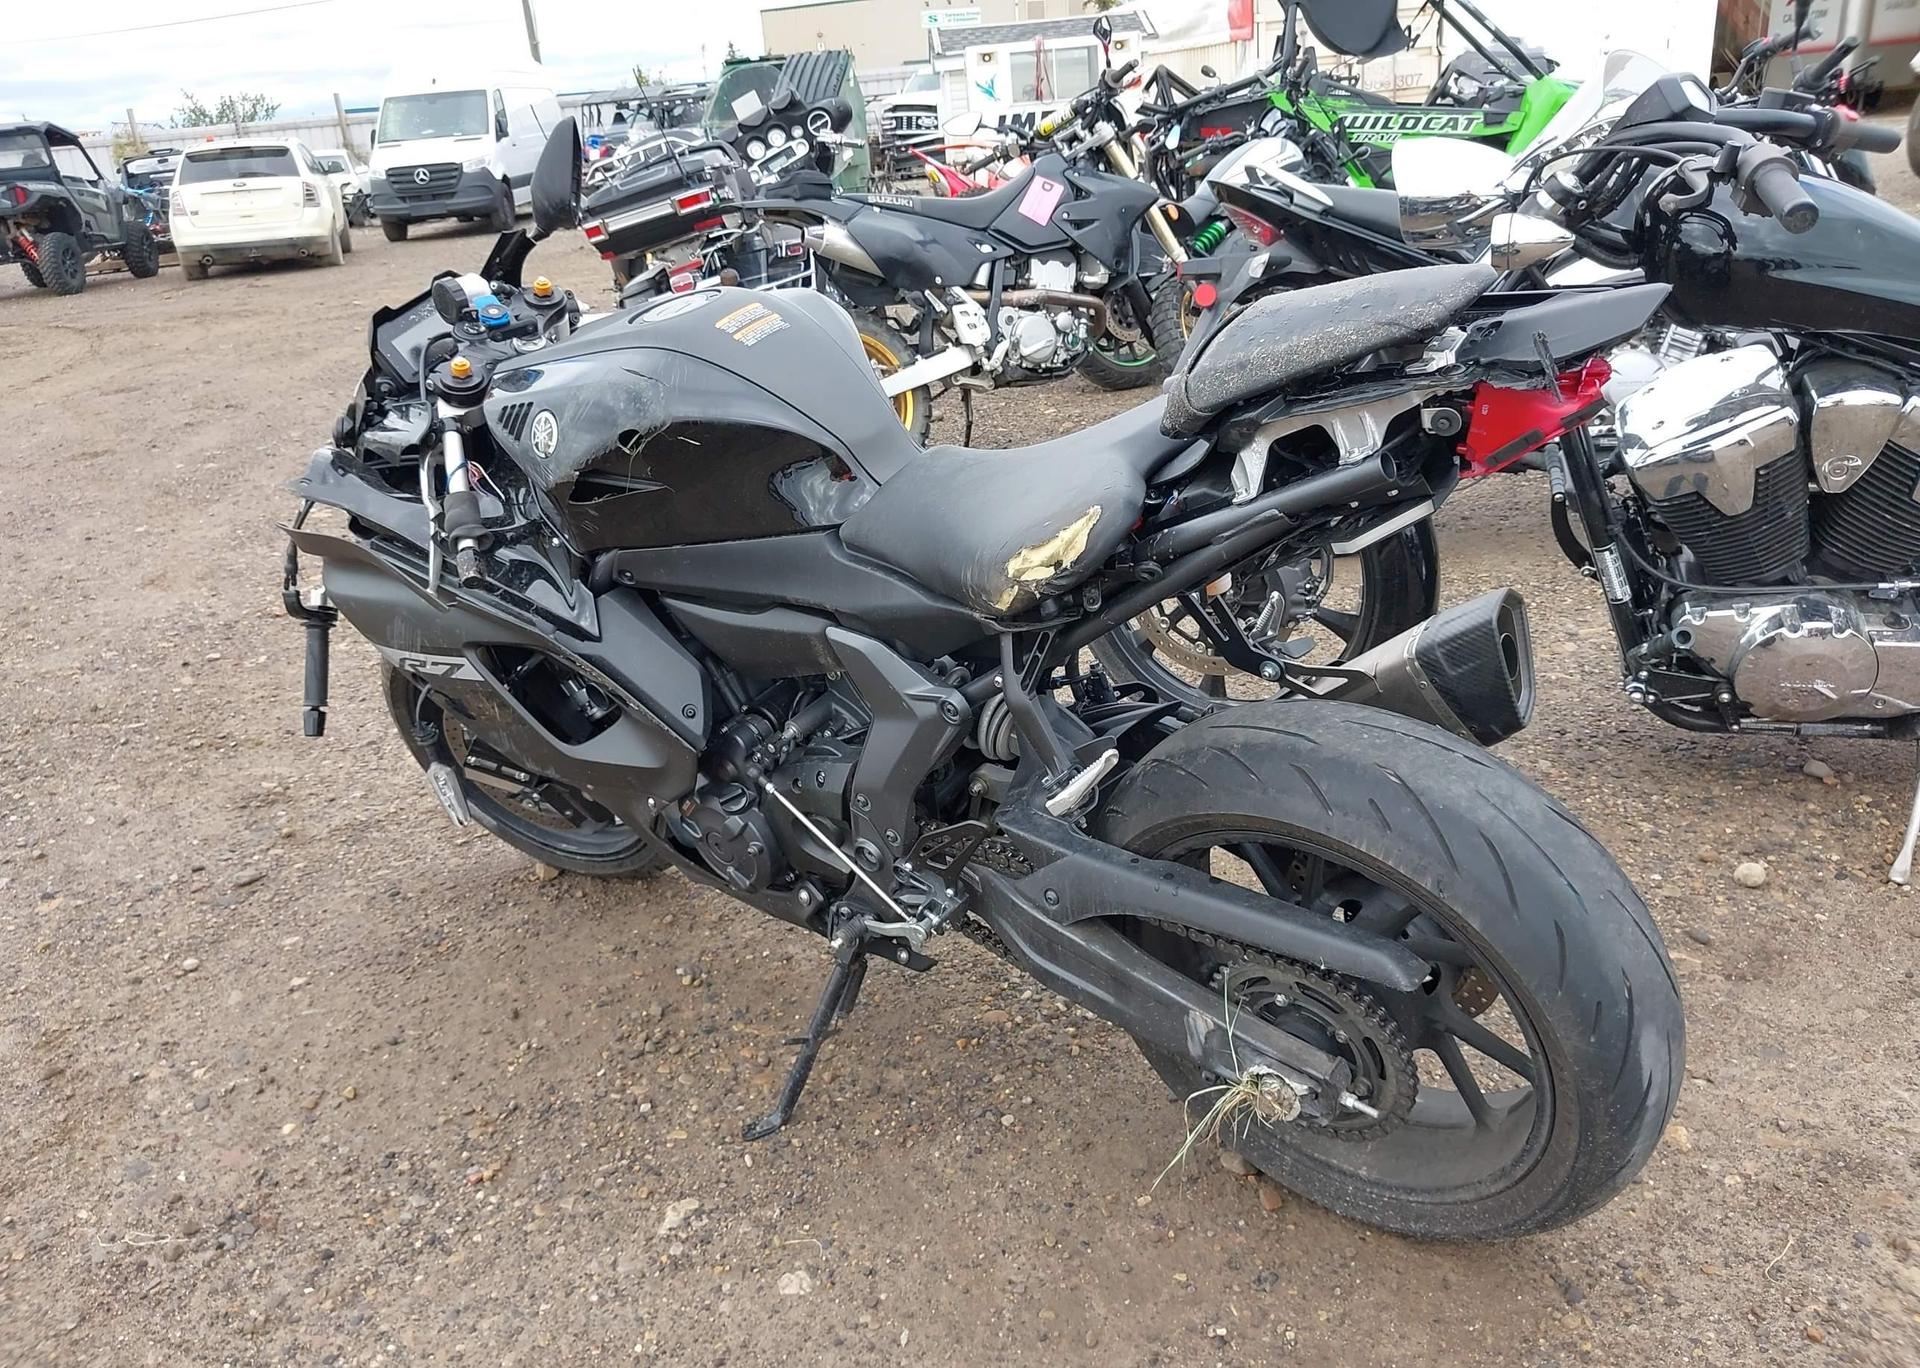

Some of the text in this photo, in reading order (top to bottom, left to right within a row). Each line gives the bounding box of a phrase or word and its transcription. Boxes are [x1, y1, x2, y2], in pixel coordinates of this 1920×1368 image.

[1339, 114, 1483, 132] WILDCAT
[867, 195, 914, 208] SUZUKI
[398, 657, 466, 680] R7
